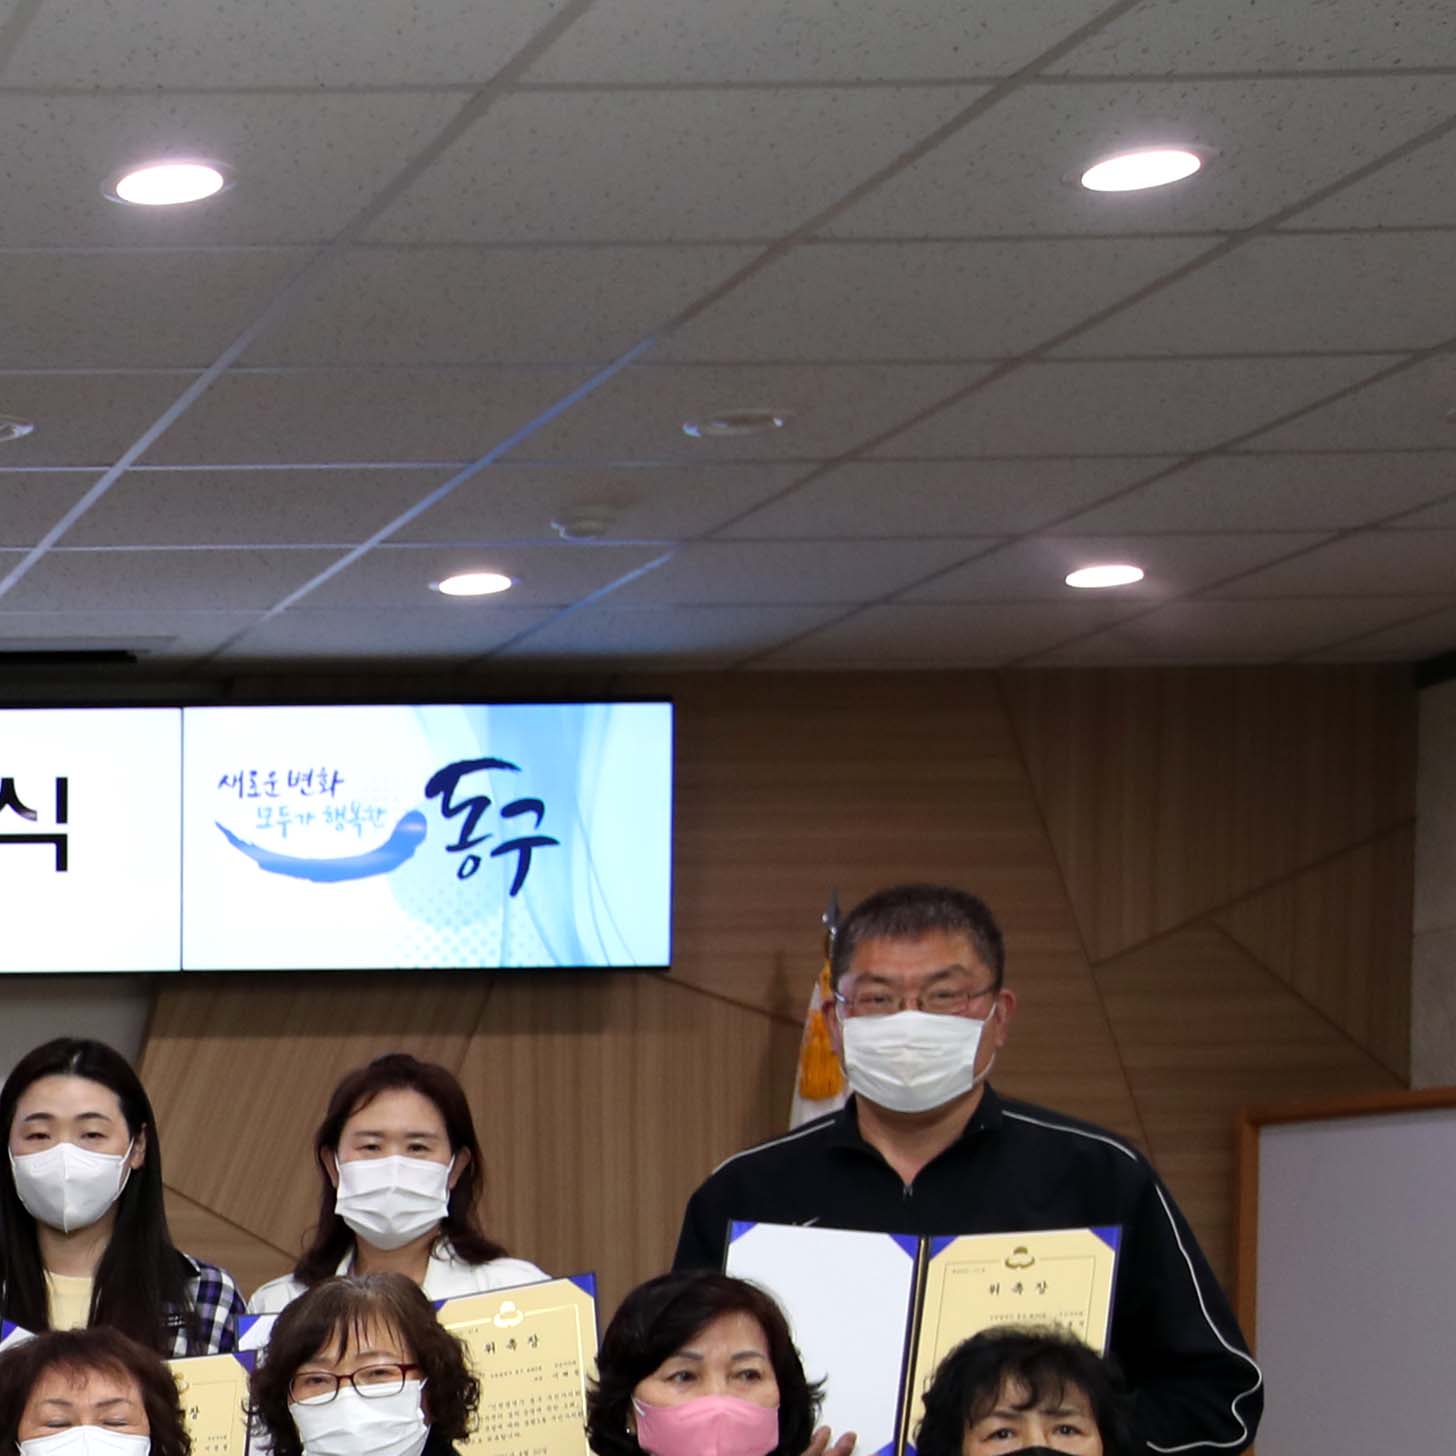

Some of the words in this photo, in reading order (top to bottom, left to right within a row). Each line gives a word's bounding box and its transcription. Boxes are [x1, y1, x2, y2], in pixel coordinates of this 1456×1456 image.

[218, 769, 281, 799] 새로운
[288, 767, 344, 799] 변화
[256, 805, 316, 839] 모두가
[324, 802, 388, 840] 행복한
[424, 757, 560, 898] 동구
